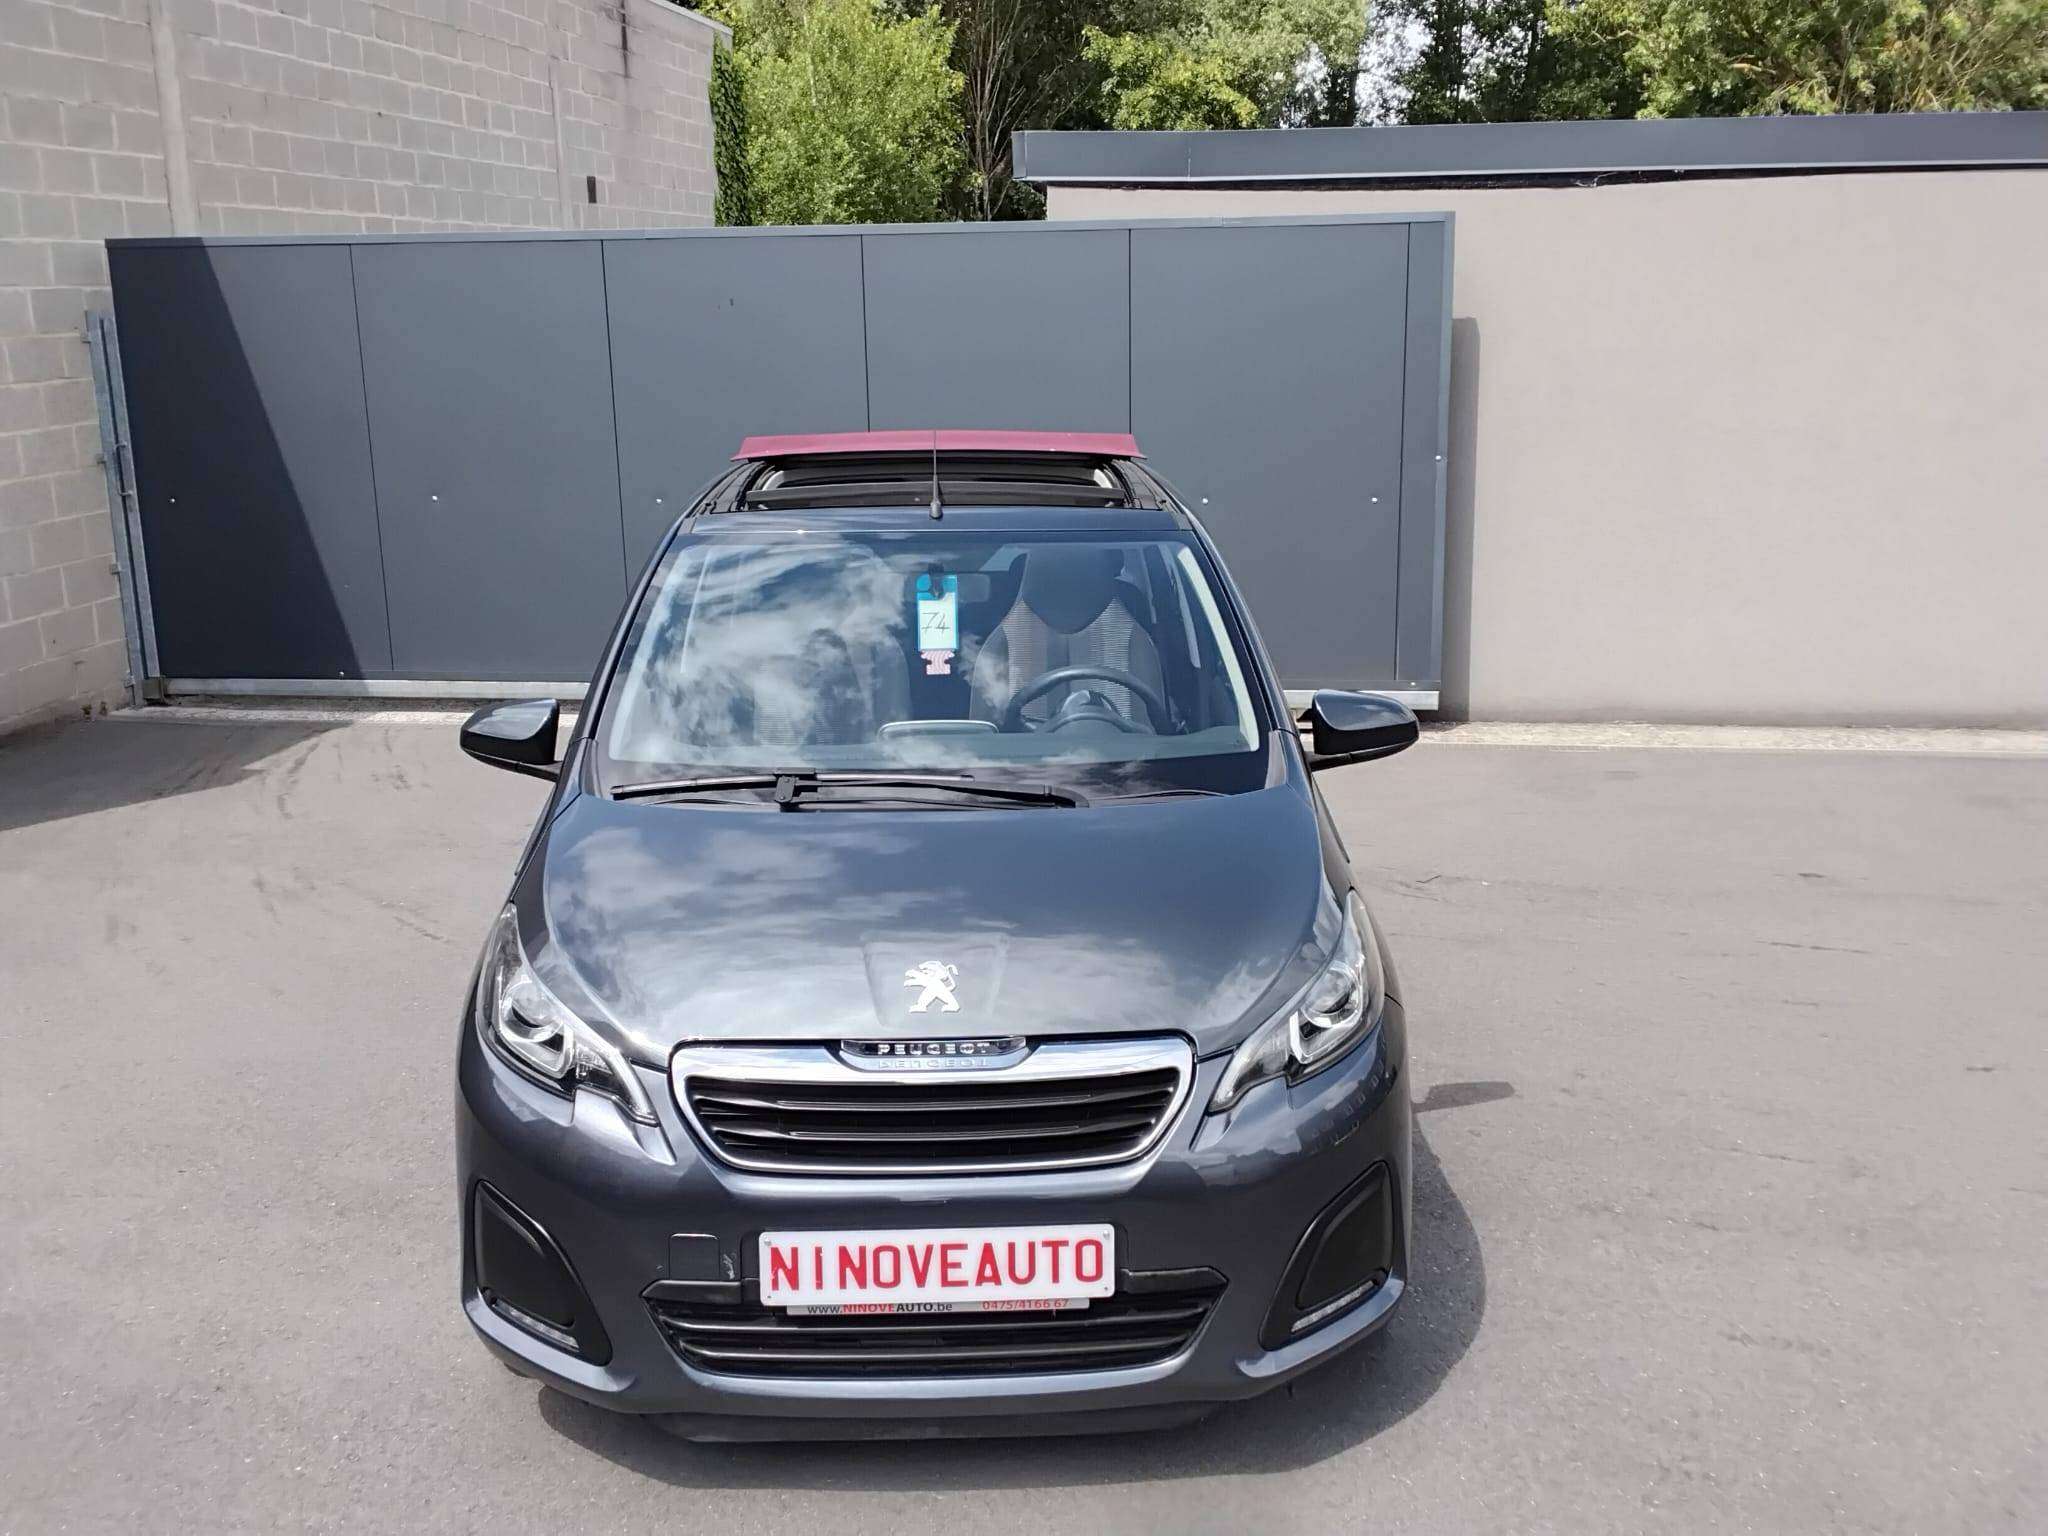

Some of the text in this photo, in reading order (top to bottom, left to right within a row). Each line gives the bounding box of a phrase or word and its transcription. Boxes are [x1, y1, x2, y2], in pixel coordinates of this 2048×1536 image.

[921, 611, 951, 635] 74
[877, 1042, 991, 1056] PEUGEOT
[770, 1238, 1105, 1292] NINOVEAUTO
[806, 1301, 953, 1315] www.NINOVEAUTO.be
